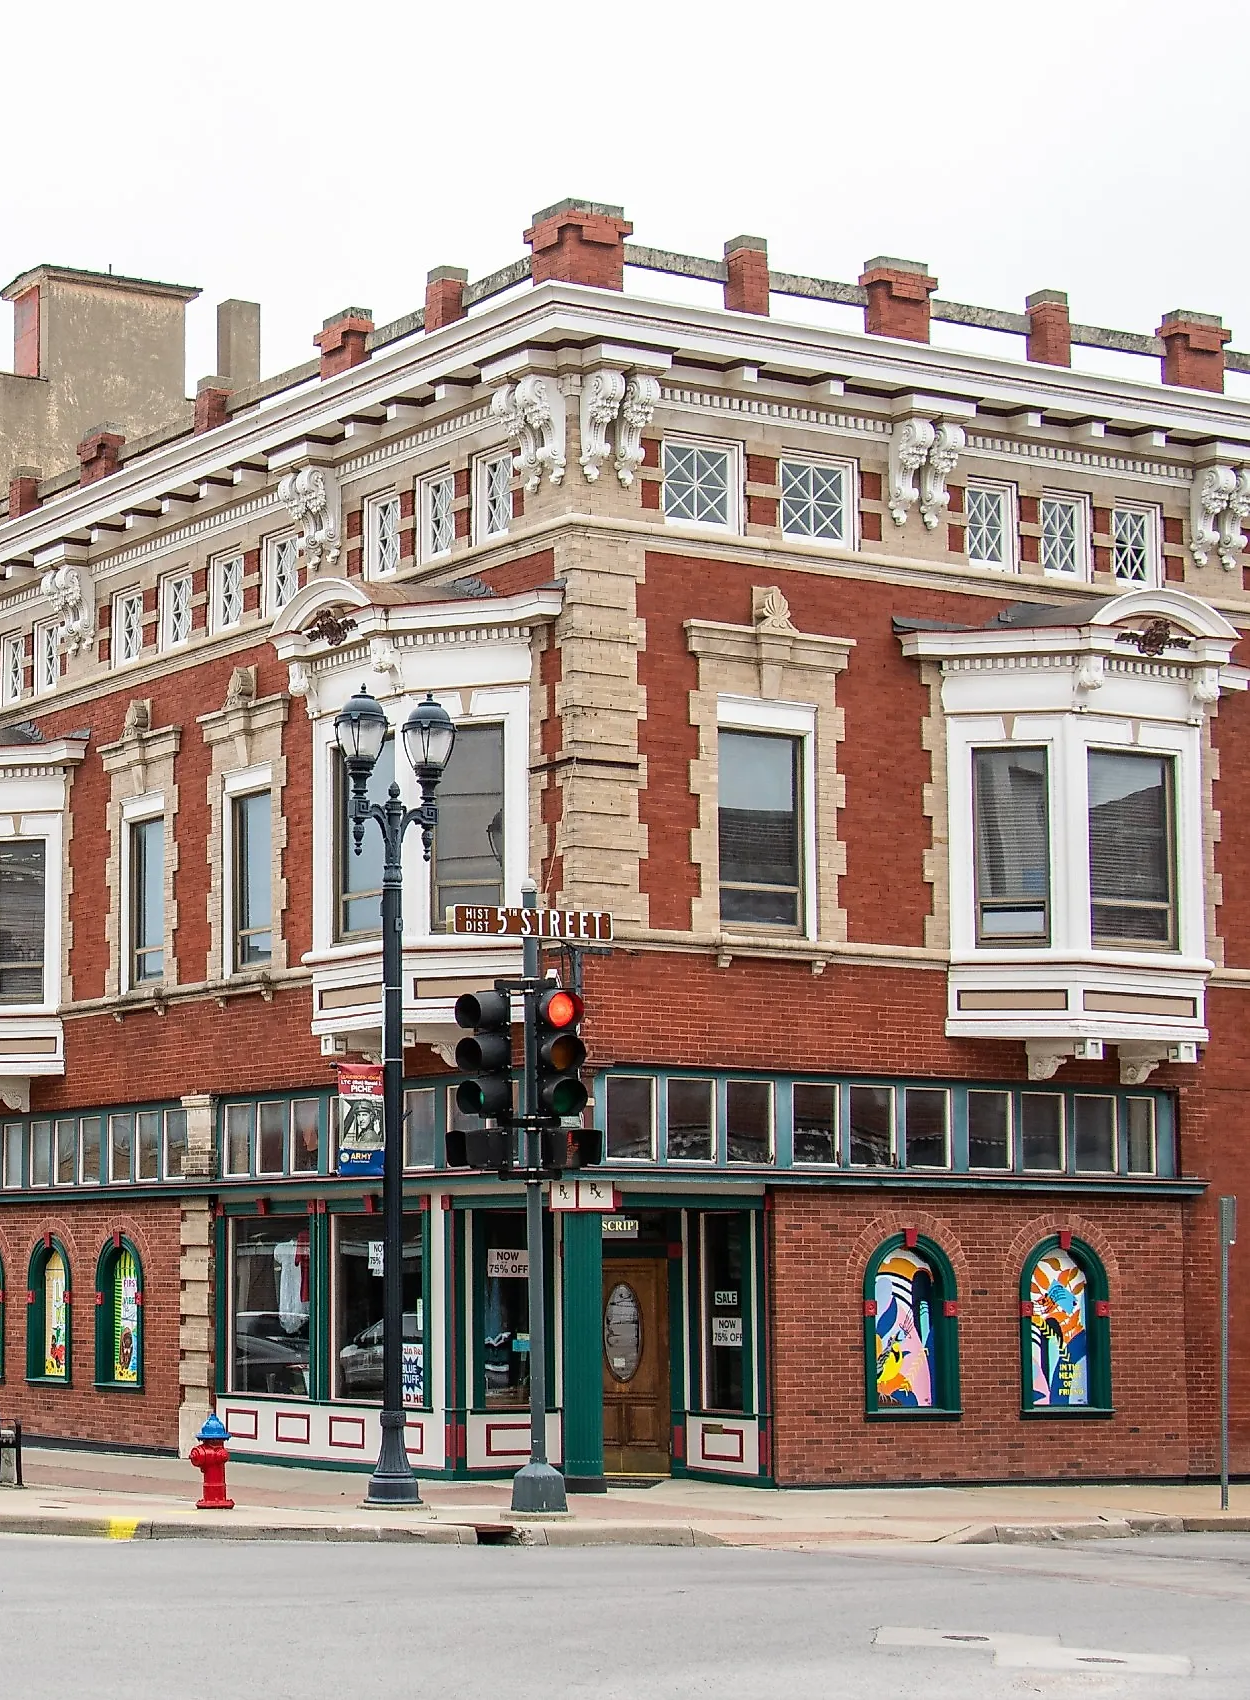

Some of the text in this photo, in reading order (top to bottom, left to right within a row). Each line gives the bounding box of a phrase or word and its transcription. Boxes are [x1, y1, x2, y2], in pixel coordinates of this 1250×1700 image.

[465, 908, 489, 920] HIST
[466, 921, 489, 932] DIST
[520, 909, 602, 939] STREET
[350, 1152, 372, 1160] ARMY
[496, 1251, 519, 1261] NOW
[489, 1264, 528, 1274] 75% OFF
[716, 1292, 737, 1304] SALE
[718, 1319, 737, 1329] NOW
[714, 1332, 729, 1342] 75%
